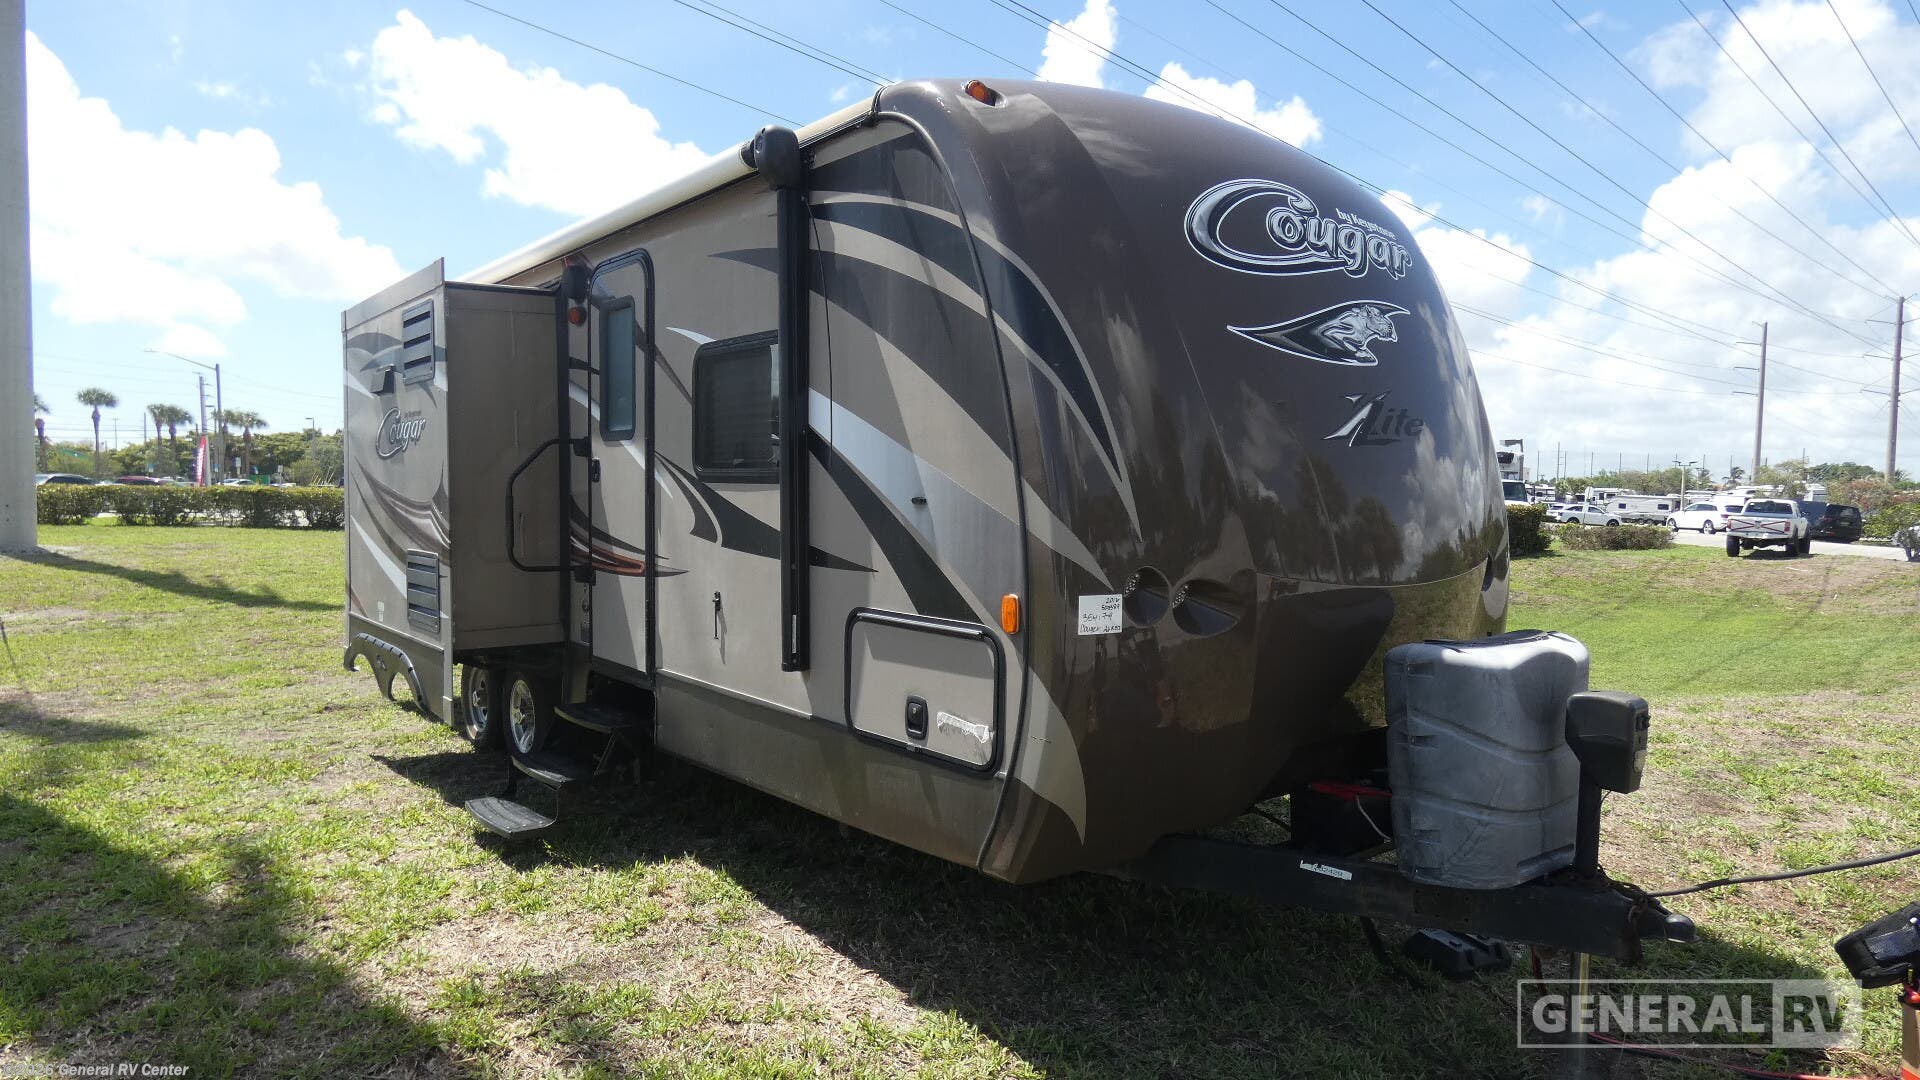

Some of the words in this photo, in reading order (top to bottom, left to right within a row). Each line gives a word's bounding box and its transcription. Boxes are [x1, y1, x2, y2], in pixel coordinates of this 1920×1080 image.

[1184, 179, 1413, 280] Cougar
[1335, 207, 1353, 225] by
[375, 406, 426, 460] Cougar
